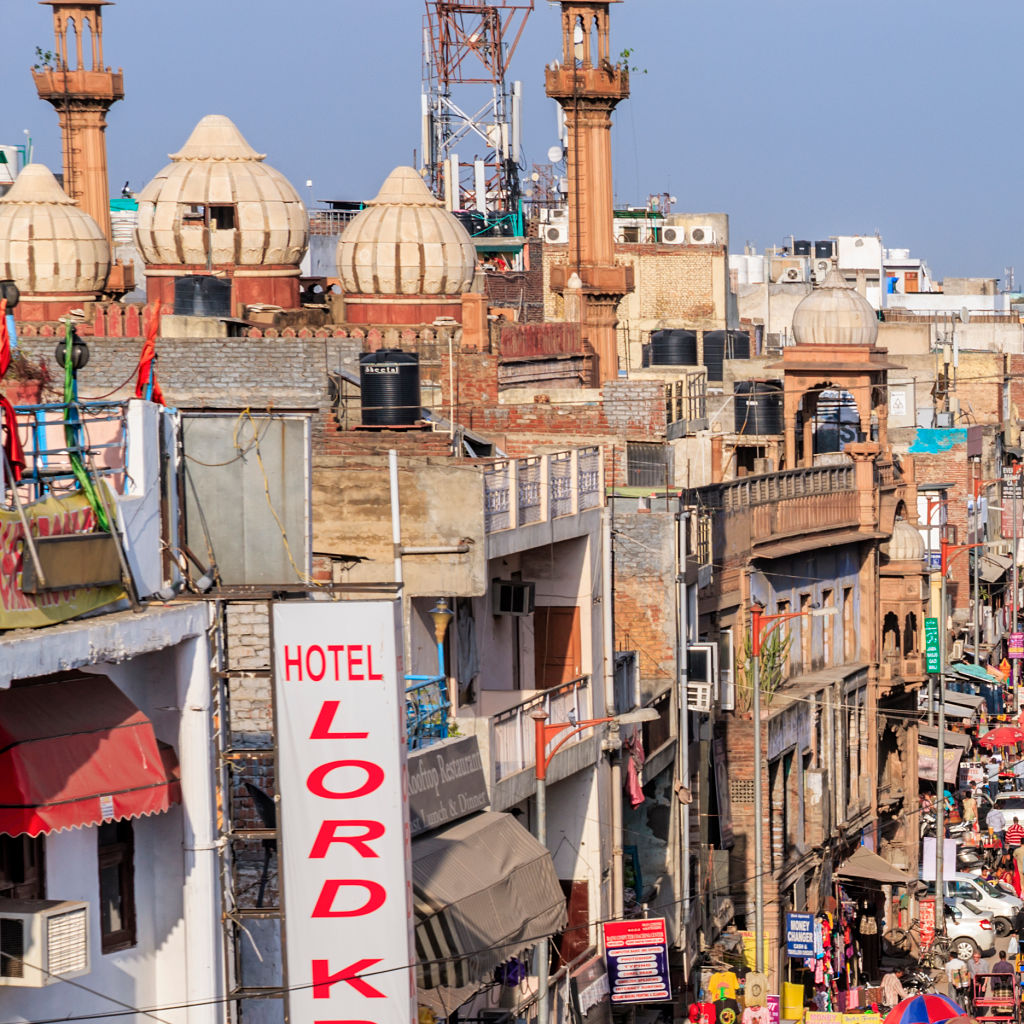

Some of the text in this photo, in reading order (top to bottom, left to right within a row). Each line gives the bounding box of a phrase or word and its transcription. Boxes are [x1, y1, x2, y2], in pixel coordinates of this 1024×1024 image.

[284, 644, 384, 682] HOTEL
[306, 700, 388, 919] LORD
[787, 931, 813, 943] CHANGER
[790, 920, 810, 932] MONEY
